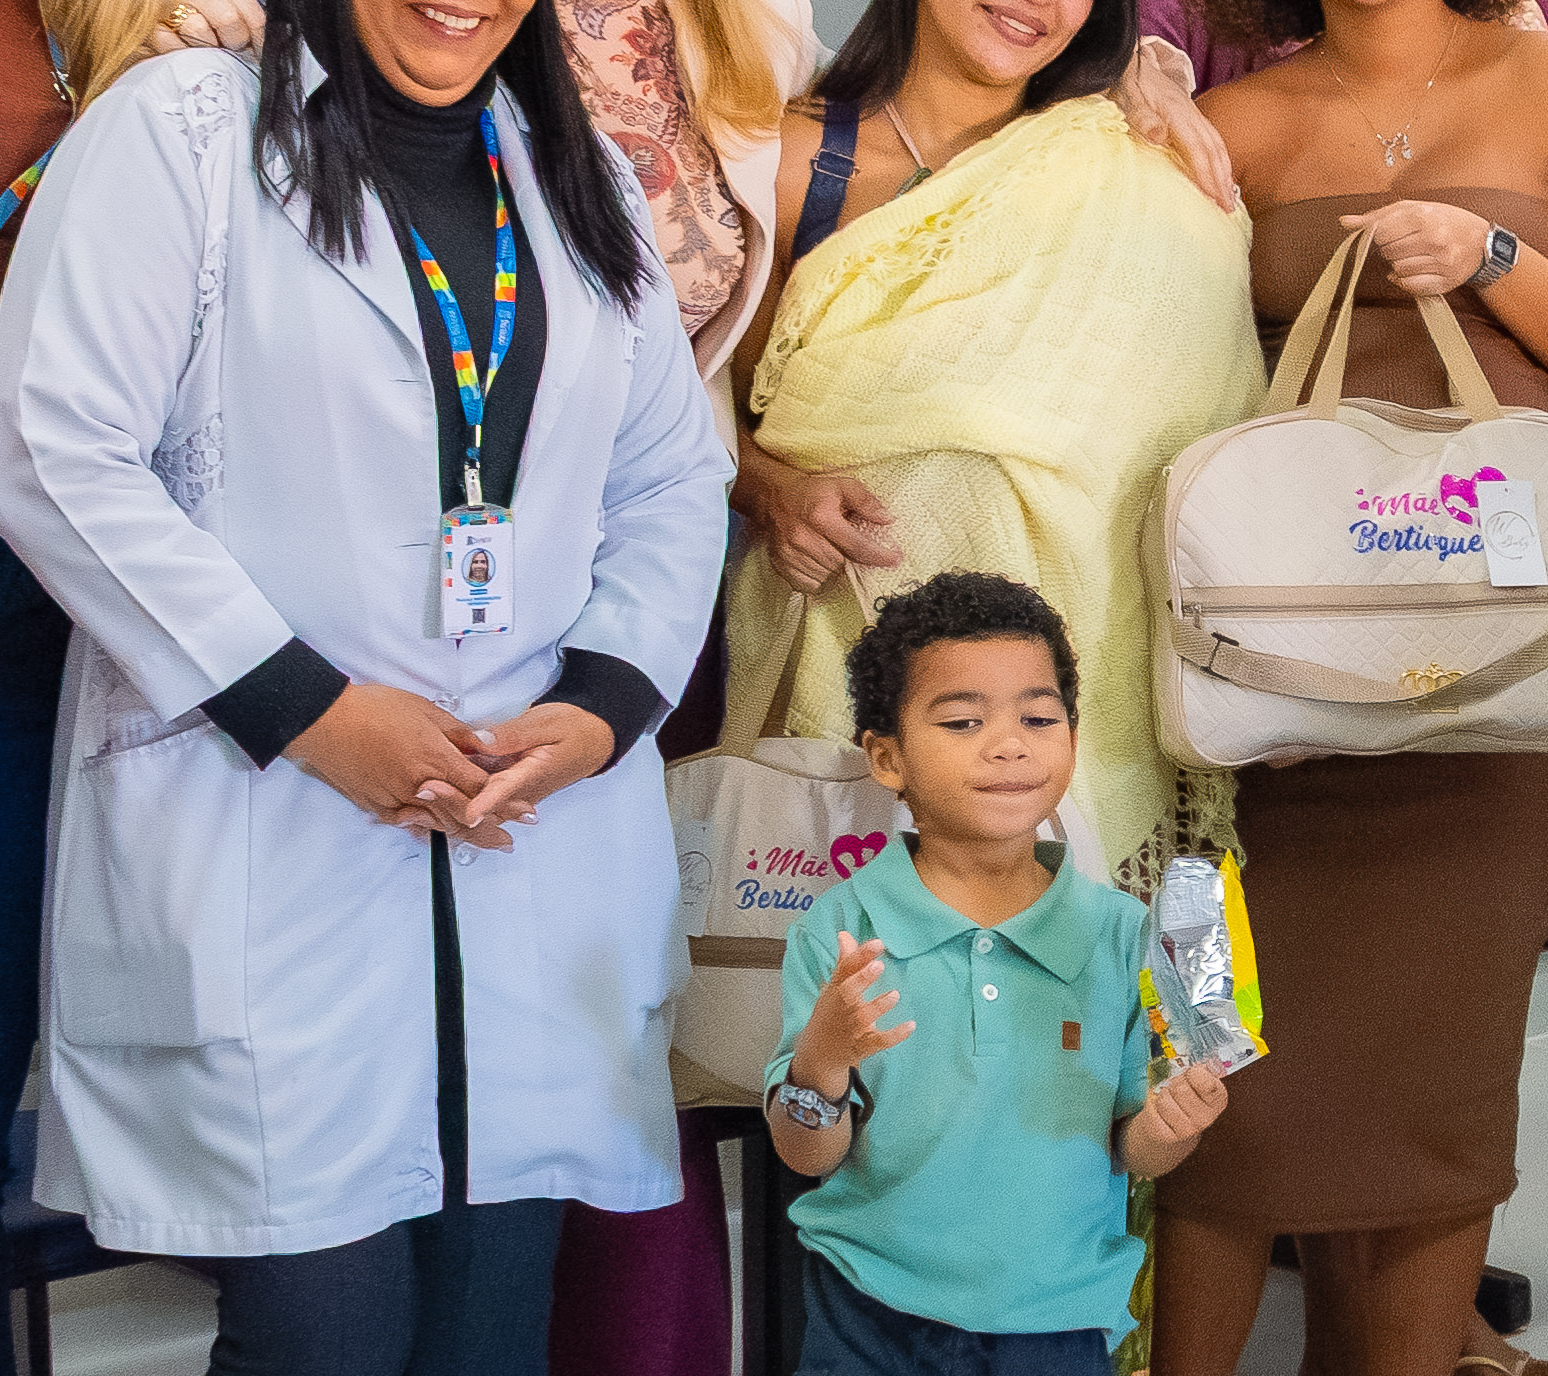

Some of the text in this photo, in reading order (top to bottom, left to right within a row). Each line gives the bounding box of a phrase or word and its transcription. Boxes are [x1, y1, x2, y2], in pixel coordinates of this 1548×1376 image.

[1348, 518, 1486, 563] Bertiogue
[765, 846, 829, 878] Mãe
[734, 878, 814, 912] Bertio
